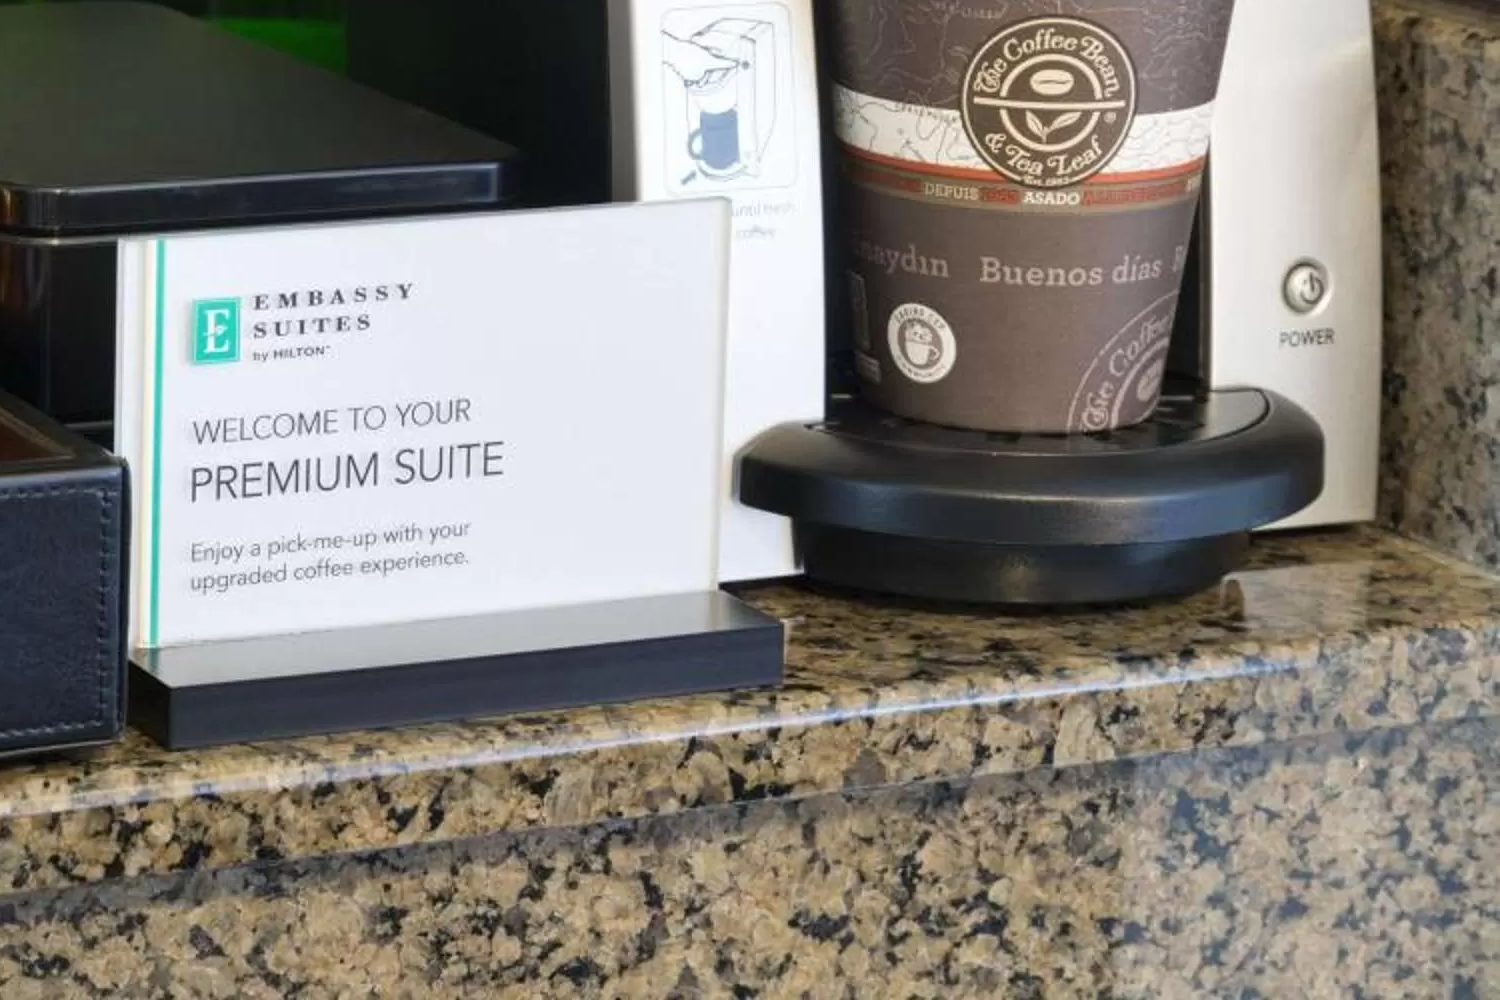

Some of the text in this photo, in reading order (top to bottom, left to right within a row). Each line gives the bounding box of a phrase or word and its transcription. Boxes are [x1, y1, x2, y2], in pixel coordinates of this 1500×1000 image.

[972, 27, 1121, 98] The Coffee Bean
[985, 133, 1103, 176] & Tea Leaf
[924, 181, 979, 201] DEPUIS
[1024, 191, 1080, 206] ASADO
[980, 256, 1103, 286] Buenos
[1112, 254, 1162, 284] días
[255, 283, 412, 311] EMBASSY
[253, 314, 371, 340] SUITES
[1278, 328, 1336, 348] POWER
[253, 346, 325, 362] by HILTON
[193, 398, 471, 445] WELCOME TO YOUR
[191, 441, 505, 503] PREMIUM SUITE
[191, 522, 472, 565] Enjoy a pick-me-up with your
[191, 551, 469, 595] upgraded coffee experience.
